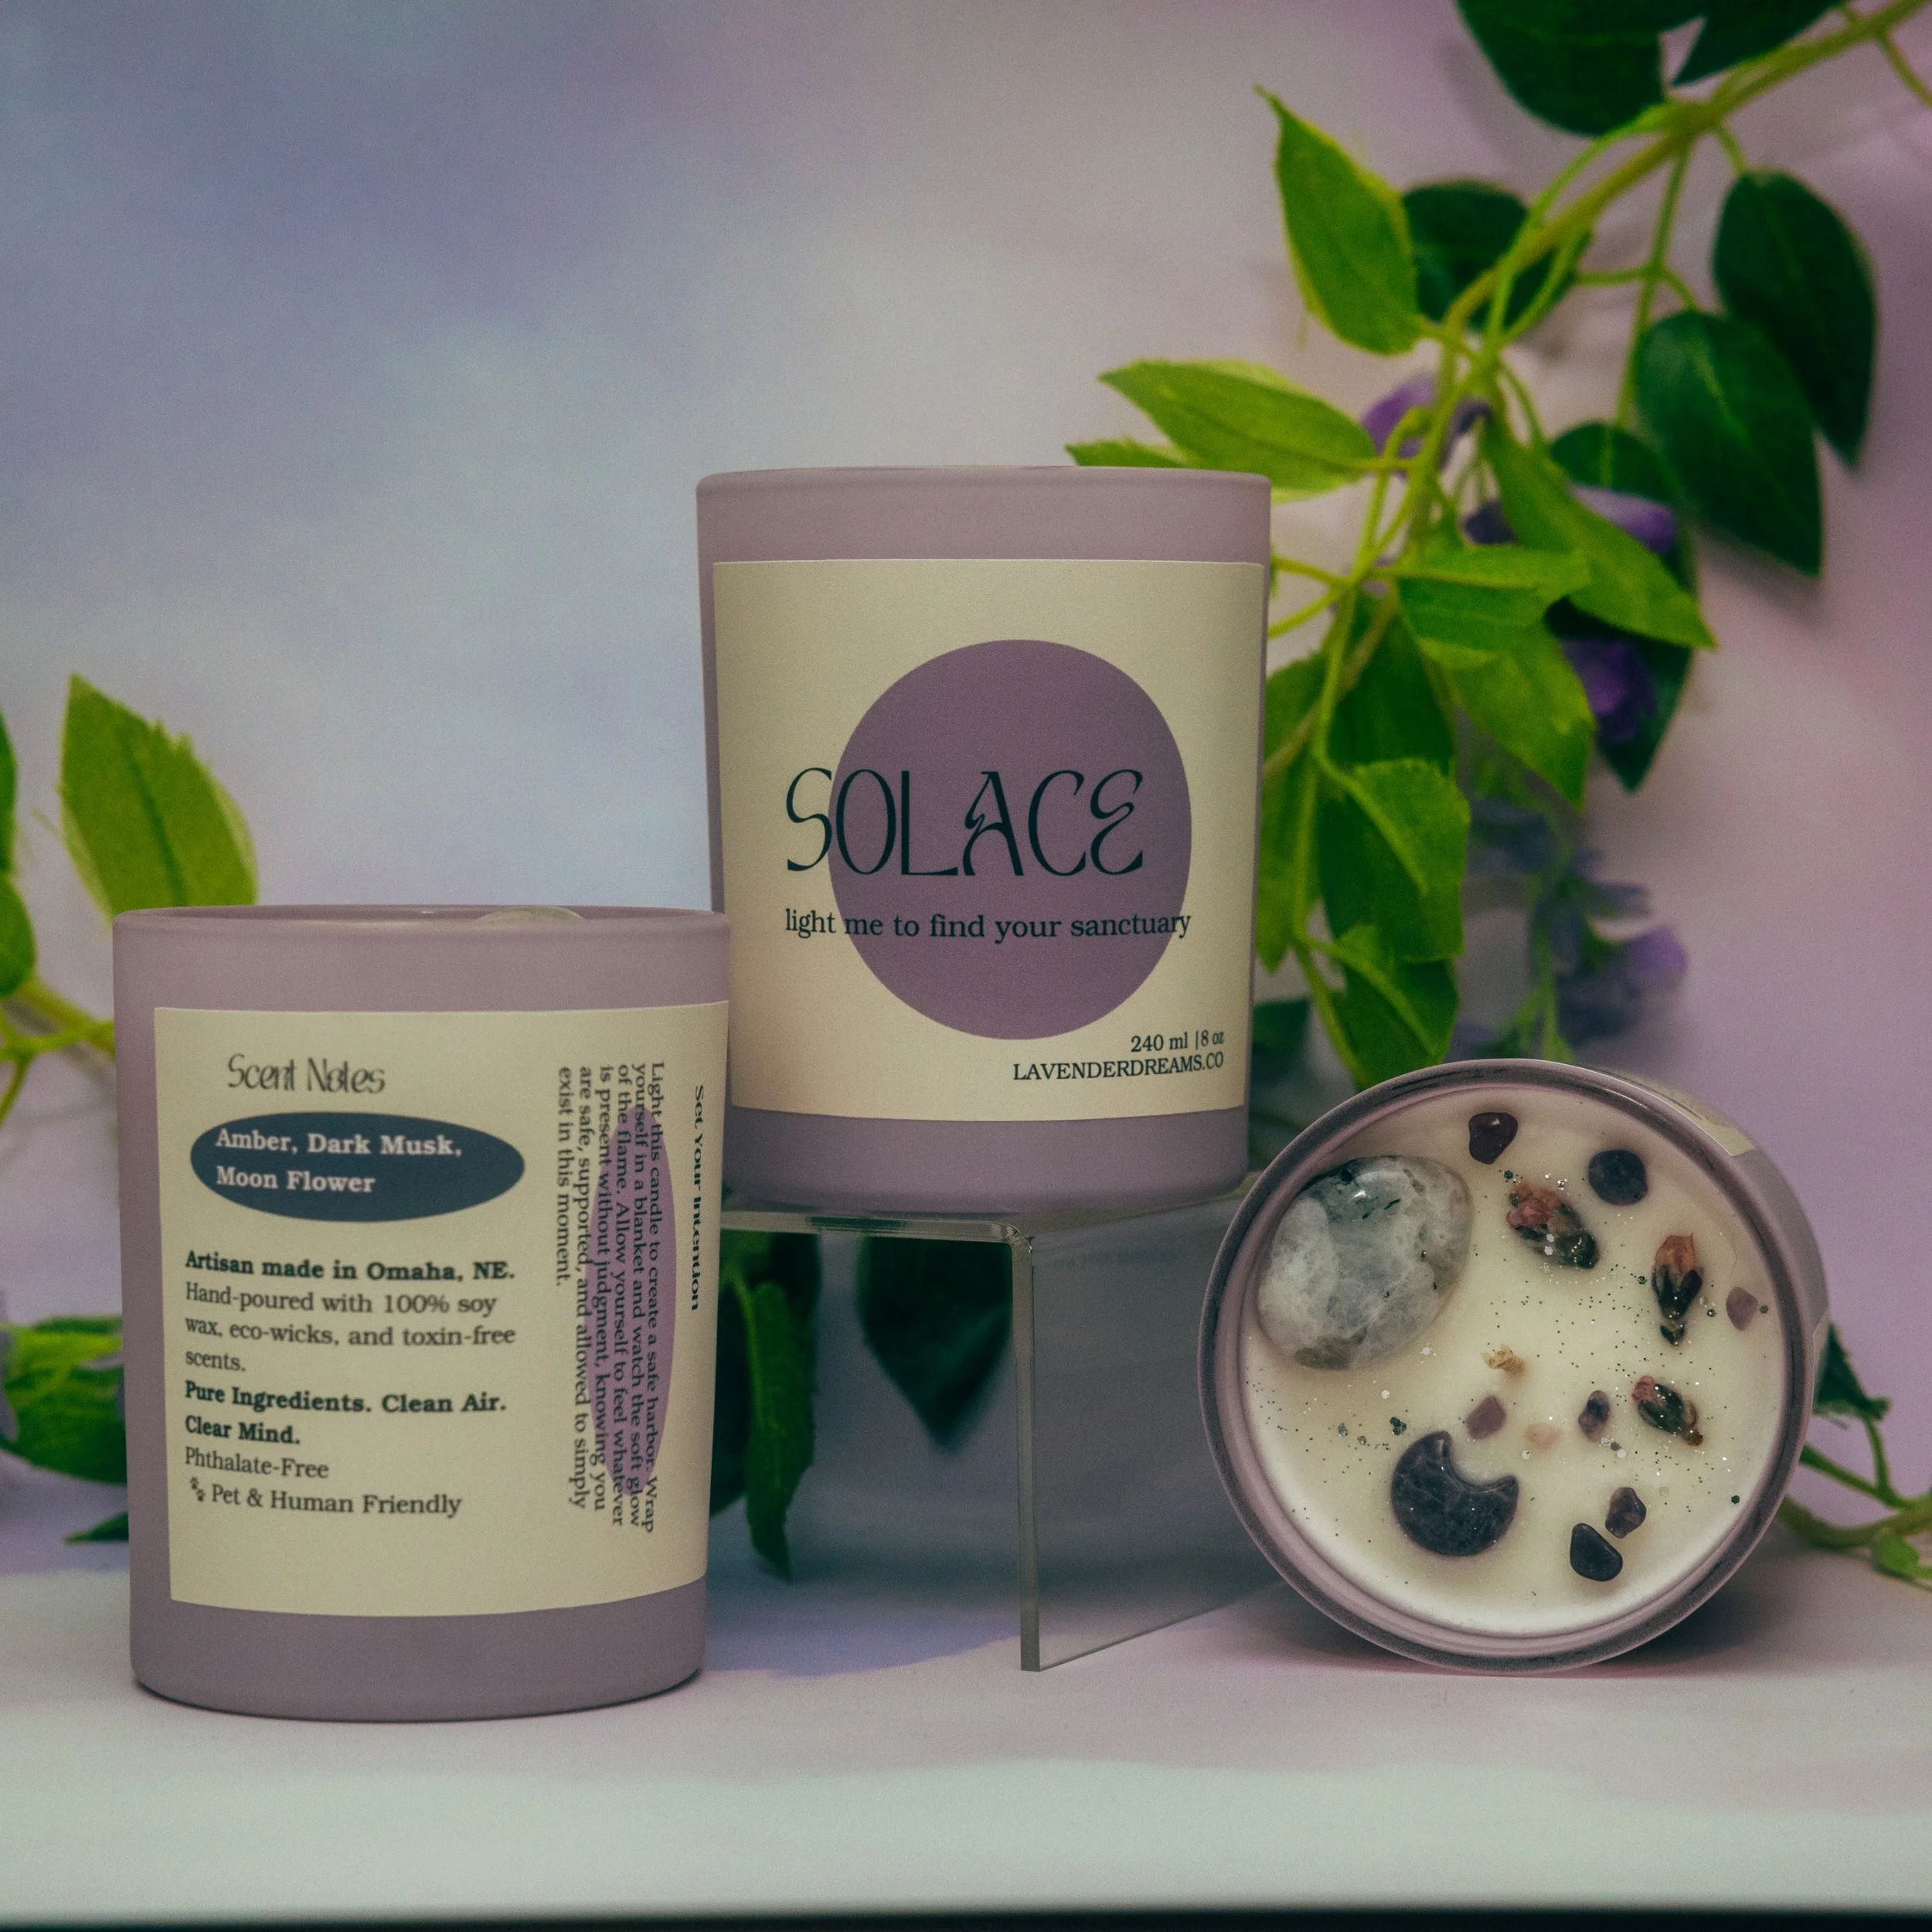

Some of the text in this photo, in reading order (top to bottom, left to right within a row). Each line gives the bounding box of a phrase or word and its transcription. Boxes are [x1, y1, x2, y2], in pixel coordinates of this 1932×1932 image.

[785, 767, 1144, 876] SOLACE
[785, 909, 1191, 944] light me to find your sanctuary
[1131, 1034, 1164, 1053] 240
[1169, 1032, 1189, 1049] ml
[1212, 1032, 1224, 1045] oz
[228, 1053, 386, 1094] Scent Notes
[1014, 1053, 1224, 1080] LAVENDERDREAMS.CO
[216, 1128, 462, 1156] Amber, Dark Musk,
[216, 1165, 376, 1193] Moon Flower
[556, 1067, 575, 1286] exist in this moment.
[691, 1085, 704, 1311] Set Your Intention
[185, 1250, 515, 1282] Artisan made in Omaha, NE.
[185, 1282, 497, 1317] Hand-poured with 100% soy
[569, 1066, 595, 1509] are safe, supported, and allowed to simply
[590, 1066, 614, 1511] is present without judgment, knowing you
[611, 1065, 631, 1526] of the flame. Allow yourself to feel whatever
[627, 1063, 648, 1526] yourself in a blanket and watch the soft glow
[642, 1062, 664, 1533] Light this candle to create a safe harbor. Wrap
[185, 1318, 516, 1346] wax, eco-wicks, and toxin-free
[185, 1349, 246, 1372] scents.
[185, 1380, 506, 1413] Pure Ingredients. Clean Air.
[185, 1415, 300, 1445] Clear Mind.
[185, 1447, 329, 1478] Phthalate-Free
[211, 1484, 462, 1519] Pet & Human Friendly
